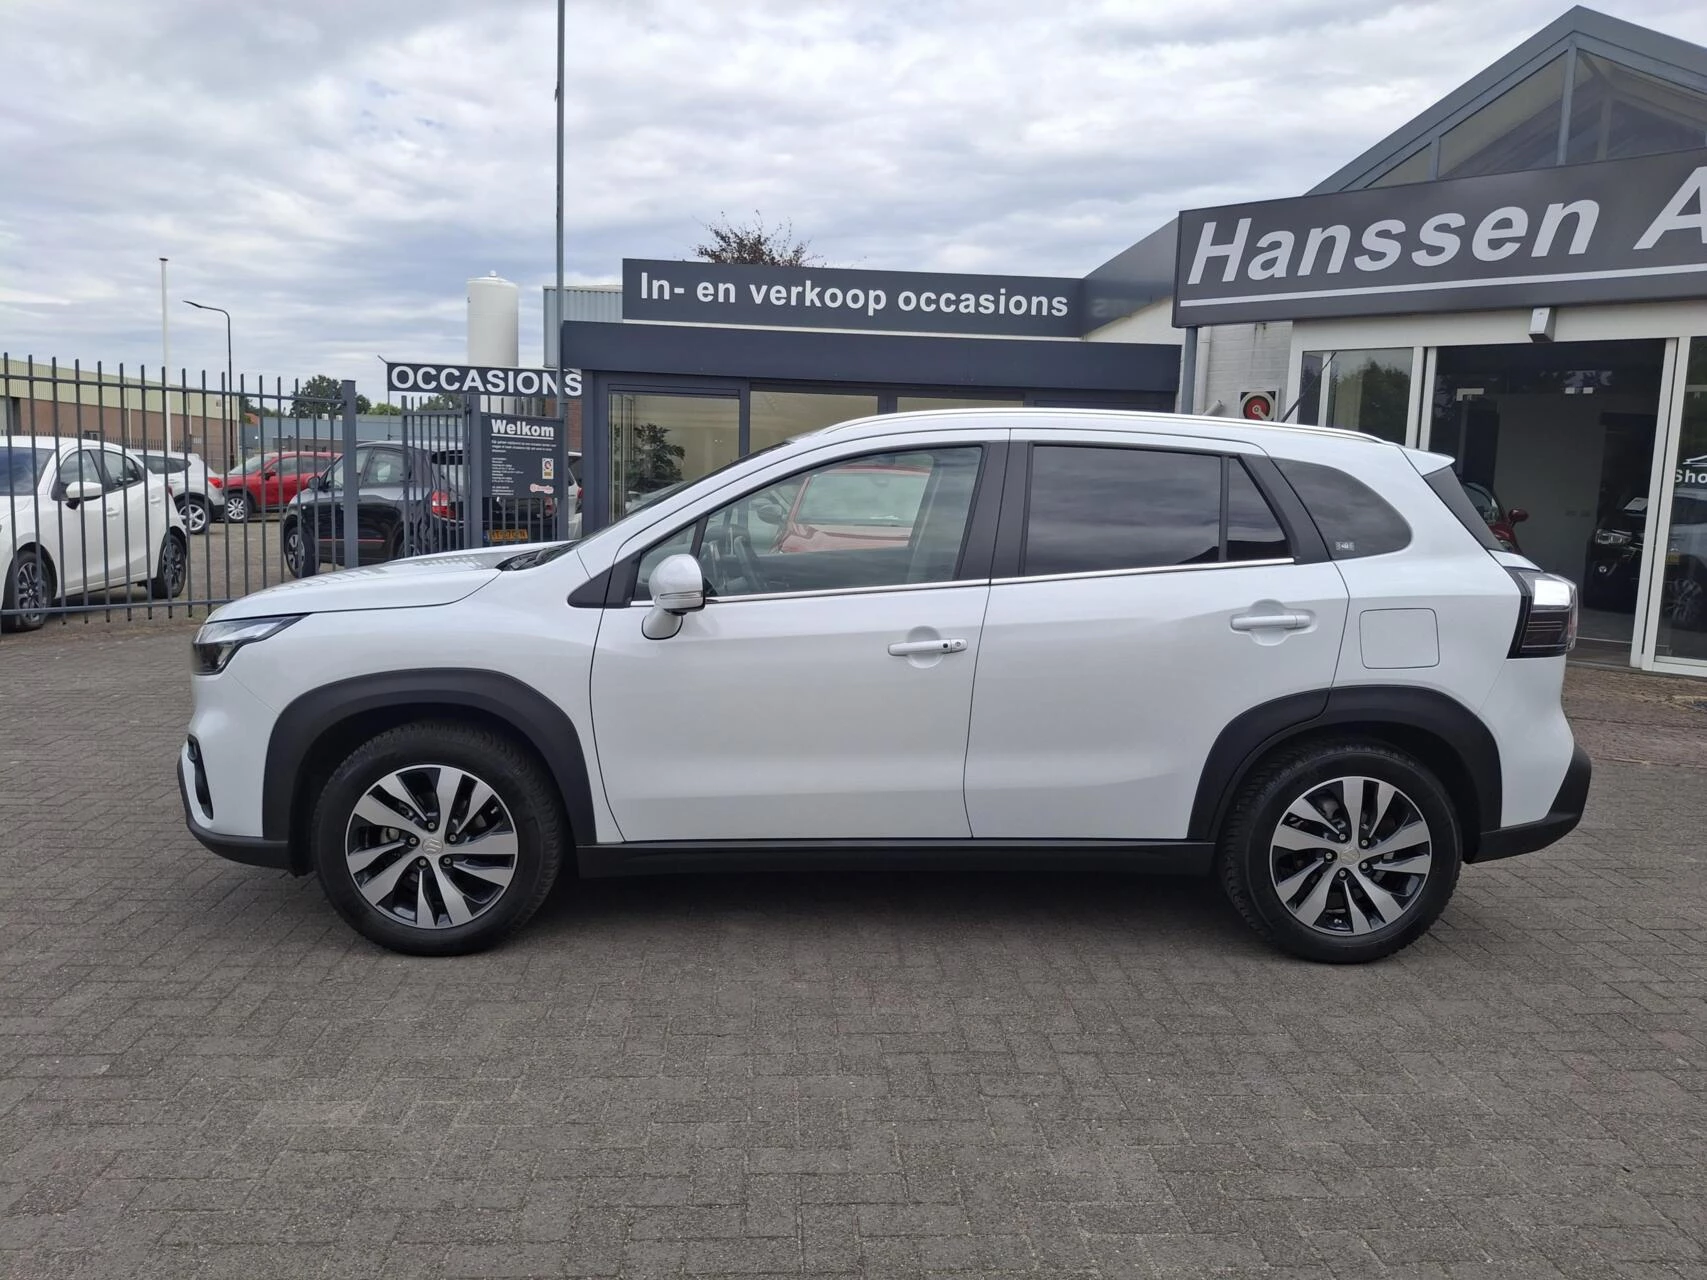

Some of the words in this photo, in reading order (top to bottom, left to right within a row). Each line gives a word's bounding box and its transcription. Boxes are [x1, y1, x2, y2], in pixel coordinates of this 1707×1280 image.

[1187, 199, 1600, 286] Hanssen
[640, 272, 684, 300] In-
[696, 282, 735, 304] en
[749, 281, 887, 316] verkoop
[897, 288, 1069, 317] occasions
[391, 365, 582, 396] OCCASIONS
[491, 418, 554, 437] Welkom
